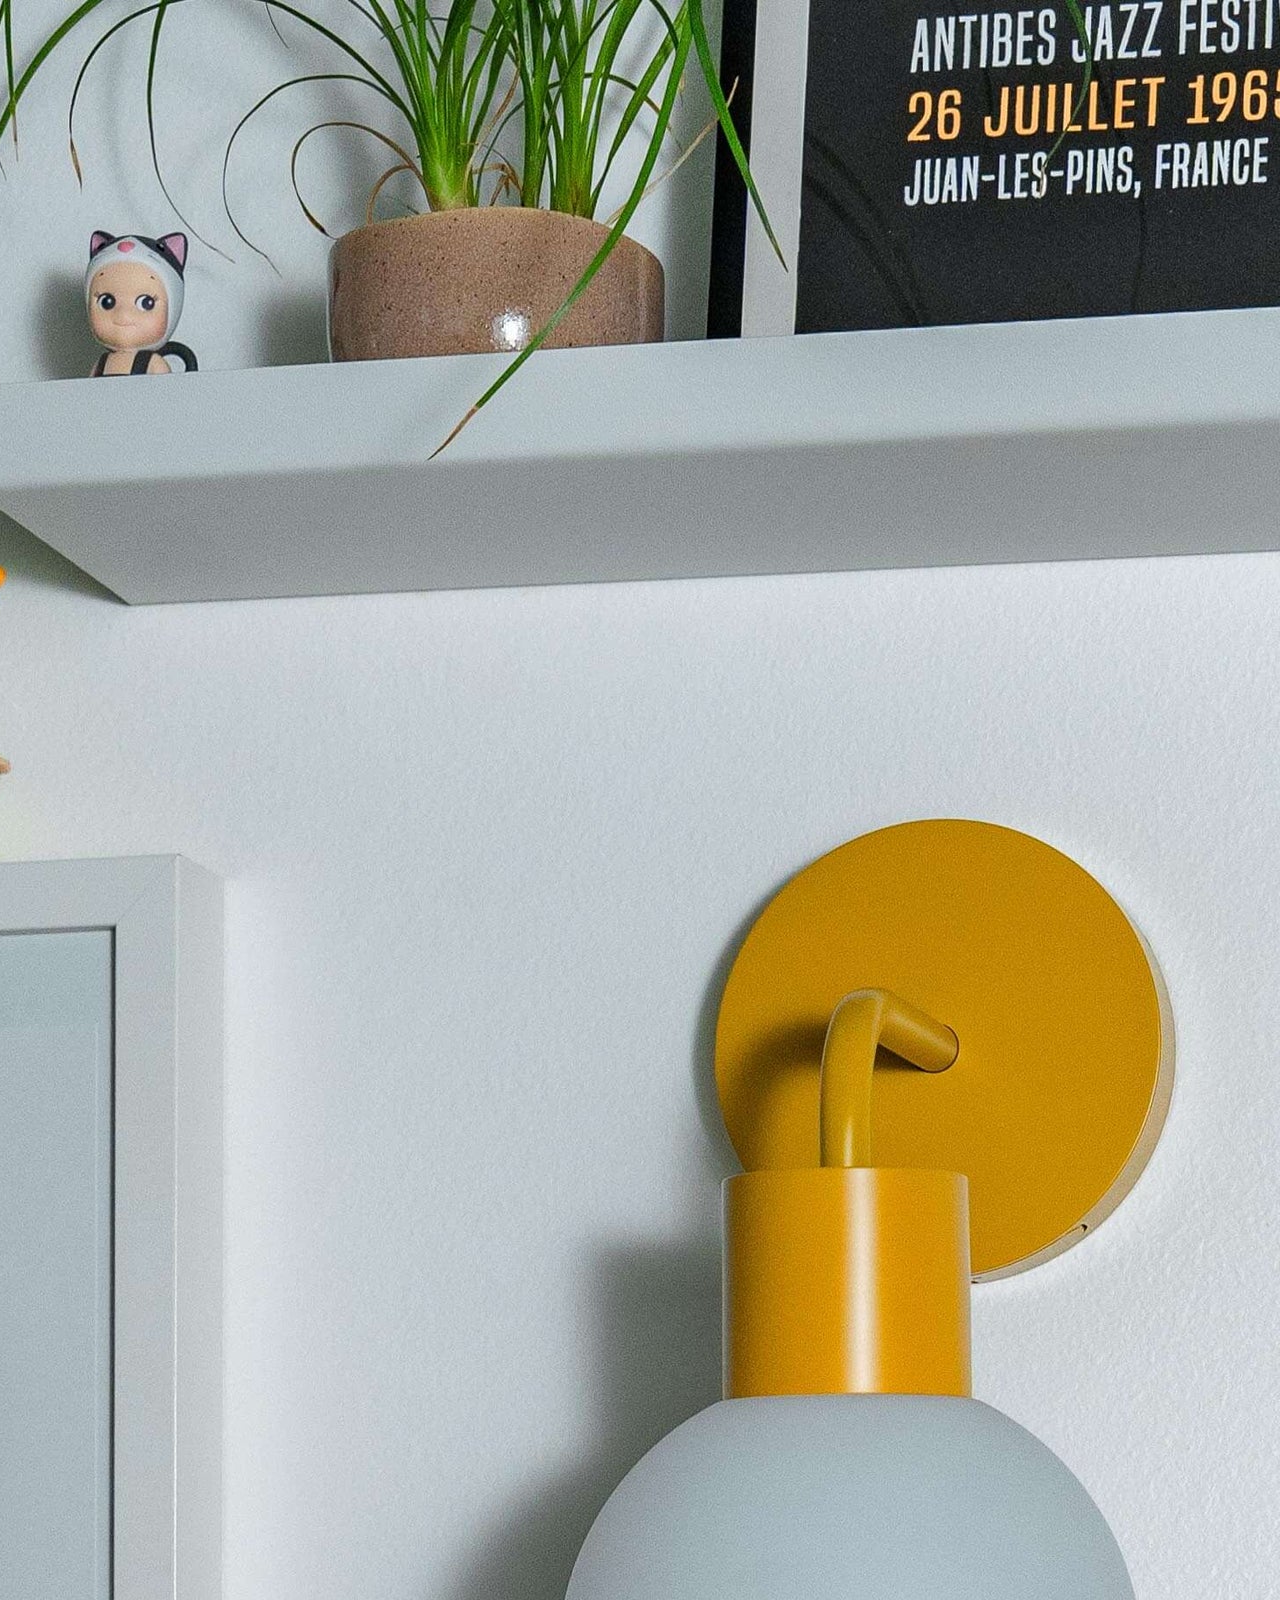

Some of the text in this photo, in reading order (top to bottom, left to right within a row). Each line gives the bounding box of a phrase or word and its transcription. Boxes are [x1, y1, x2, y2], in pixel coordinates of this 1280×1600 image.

[910, 8, 1057, 73] ANTIBES
[1071, 2, 1163, 63] JAZZ
[907, 89, 963, 142] 26
[983, 76, 1166, 138] JUILLET
[904, 136, 1269, 206] JUAN-LES-PINS, FRANCE
